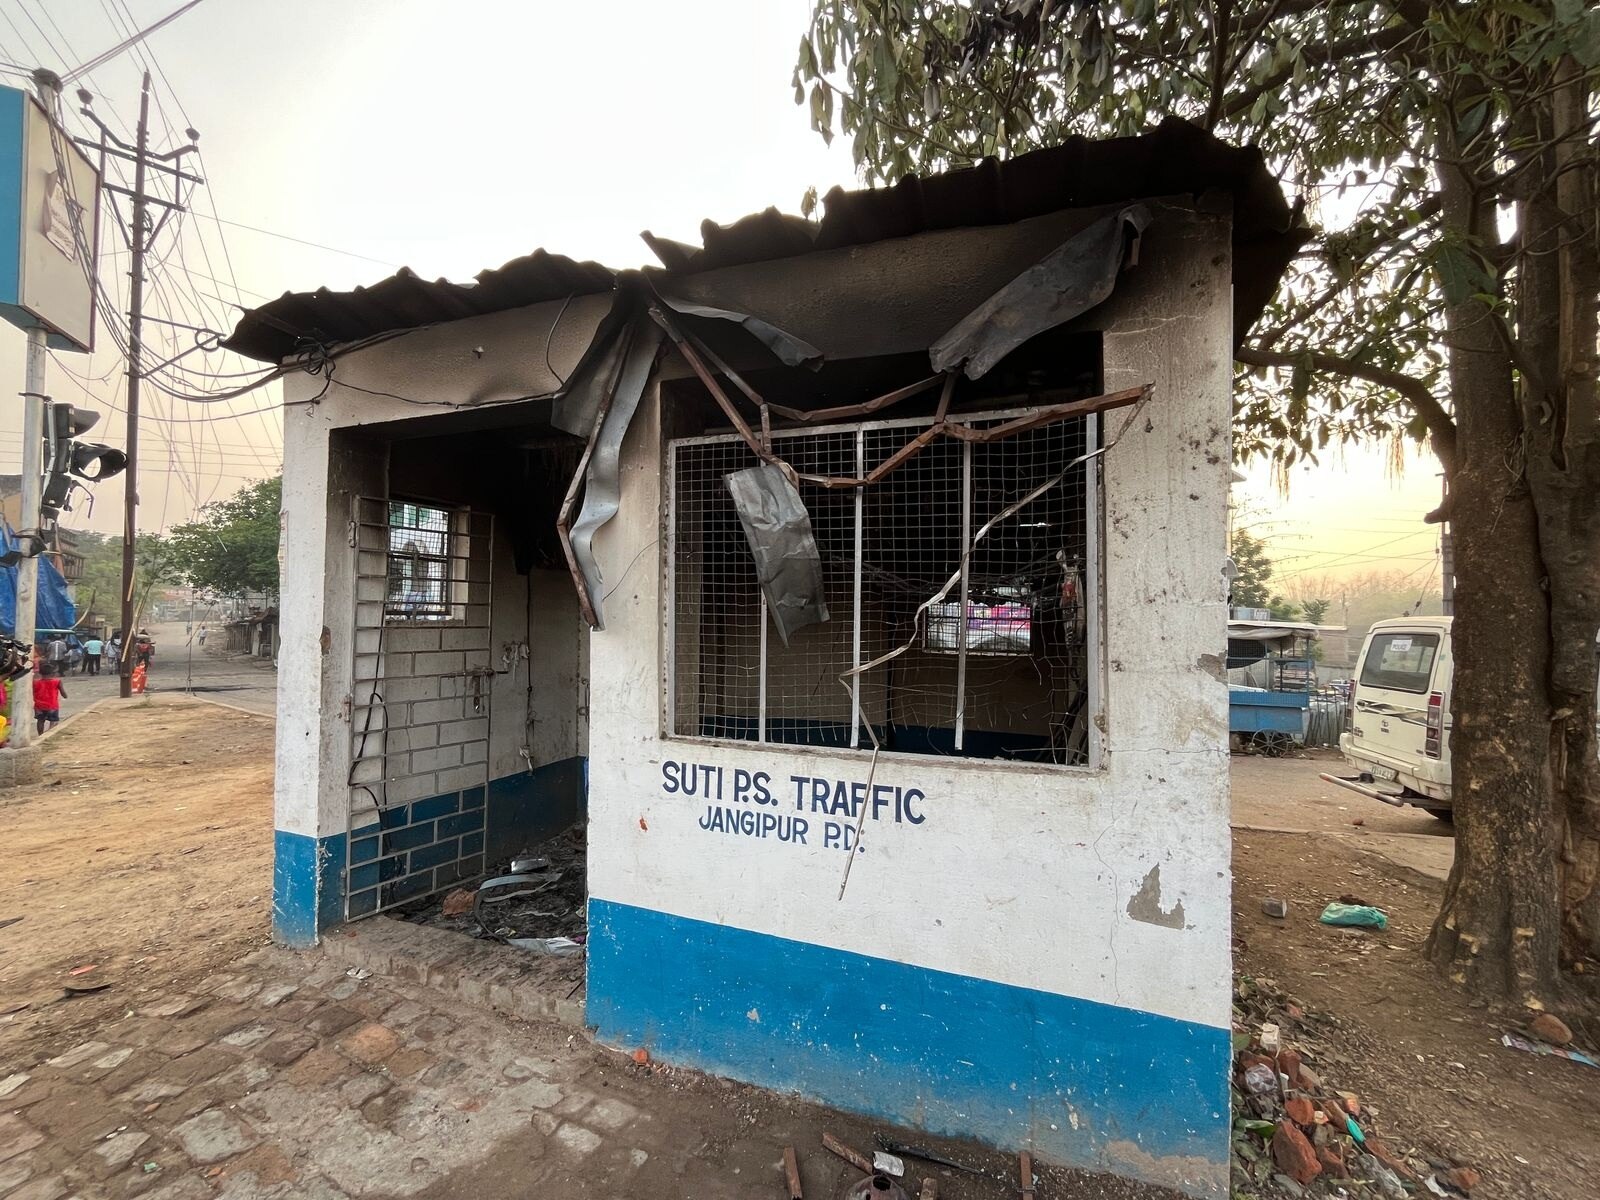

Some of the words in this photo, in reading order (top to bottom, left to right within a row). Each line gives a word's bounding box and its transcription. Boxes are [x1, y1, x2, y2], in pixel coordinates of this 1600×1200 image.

[662, 760, 723, 799] SUTI
[733, 769, 778, 807] P.S.
[790, 775, 926, 824] TRAFFIC
[699, 806, 808, 845] JANGIPUR
